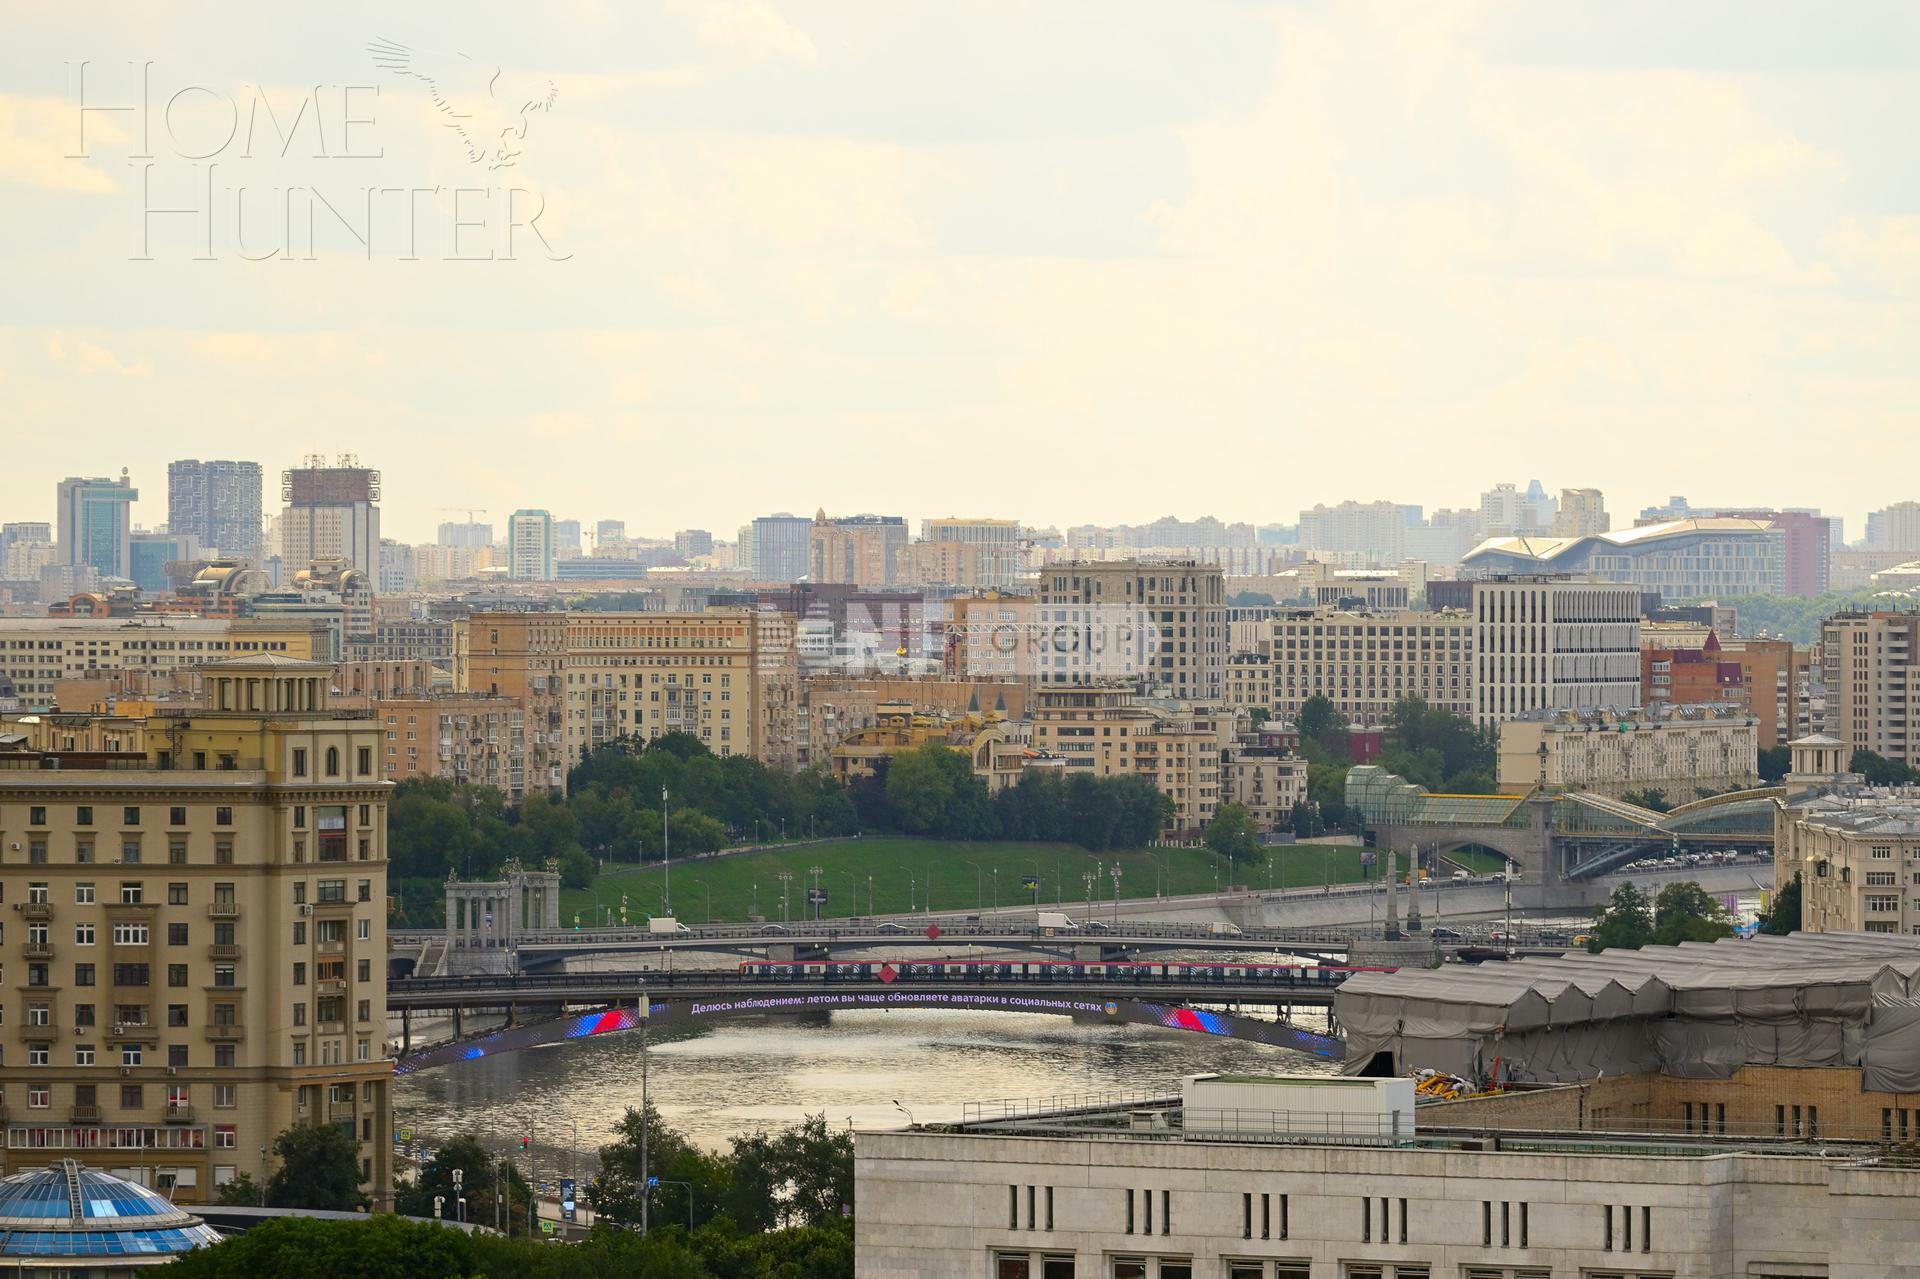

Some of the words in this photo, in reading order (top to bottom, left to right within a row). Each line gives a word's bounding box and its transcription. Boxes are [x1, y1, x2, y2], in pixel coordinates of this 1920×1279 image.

[691, 1002, 733, 1015] Делюсь
[734, 997, 804, 1009] наблюдением:
[806, 995, 839, 1004] летом
[841, 994, 855, 1003] вы
[858, 994, 885, 1003] чаще
[887, 992, 949, 1002] обновляете
[950, 994, 999, 1004] аватарки
[1009, 996, 1071, 1009] социальных
[1073, 1001, 1102, 1012] сетях
